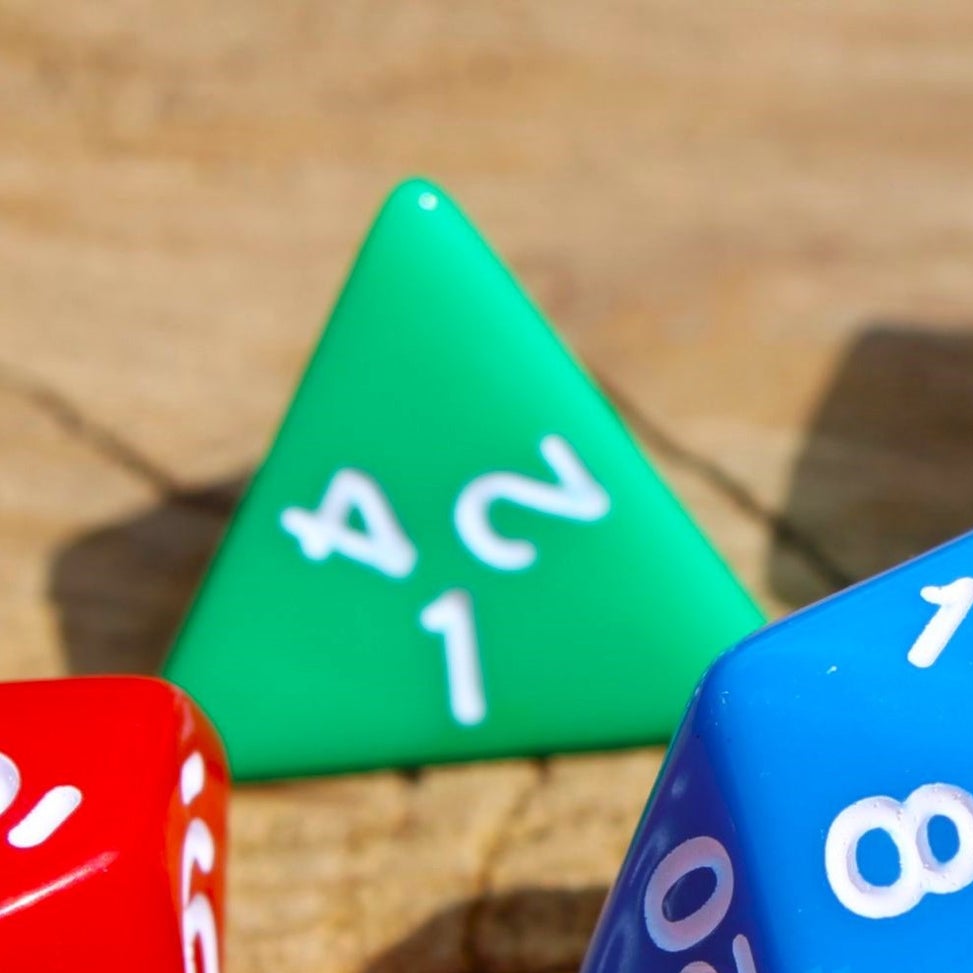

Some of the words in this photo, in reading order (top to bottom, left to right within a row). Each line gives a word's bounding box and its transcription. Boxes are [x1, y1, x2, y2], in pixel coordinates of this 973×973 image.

[280, 468, 417, 579] 4
[454, 433, 612, 572] 2
[419, 587, 488, 726] 1
